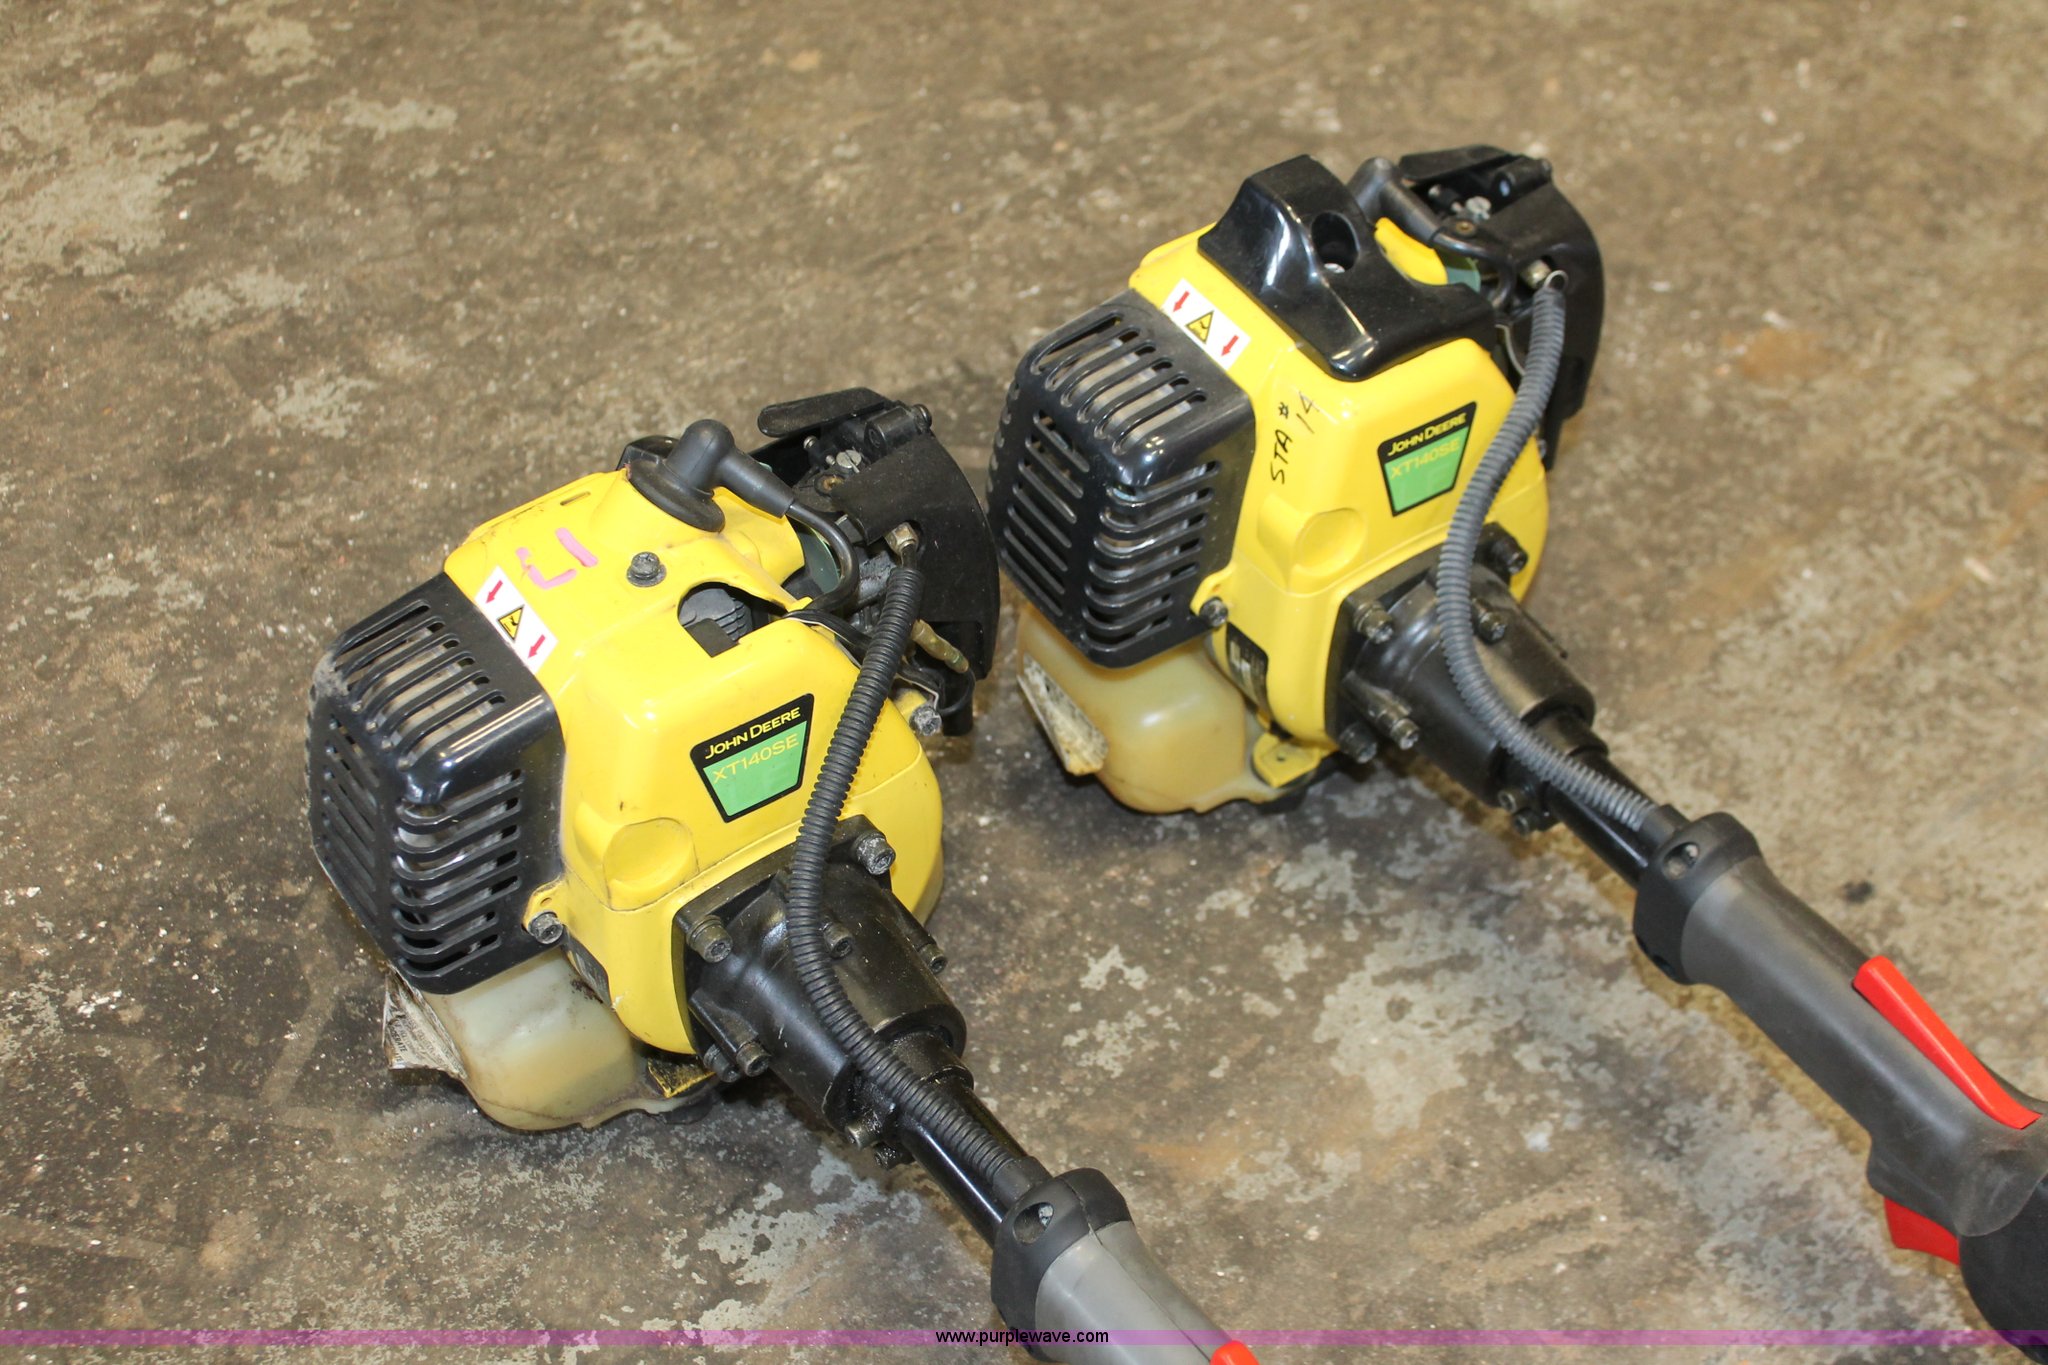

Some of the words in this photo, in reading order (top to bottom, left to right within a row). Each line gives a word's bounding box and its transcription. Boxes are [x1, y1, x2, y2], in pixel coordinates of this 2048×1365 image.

[1270, 428, 1293, 485] STA
[1387, 432, 1424, 456] JOHN
[1424, 412, 1467, 440] DEERE
[704, 731, 749, 760] JOHN
[749, 706, 801, 739] DEERE
[712, 733, 800, 784] XT140SE
